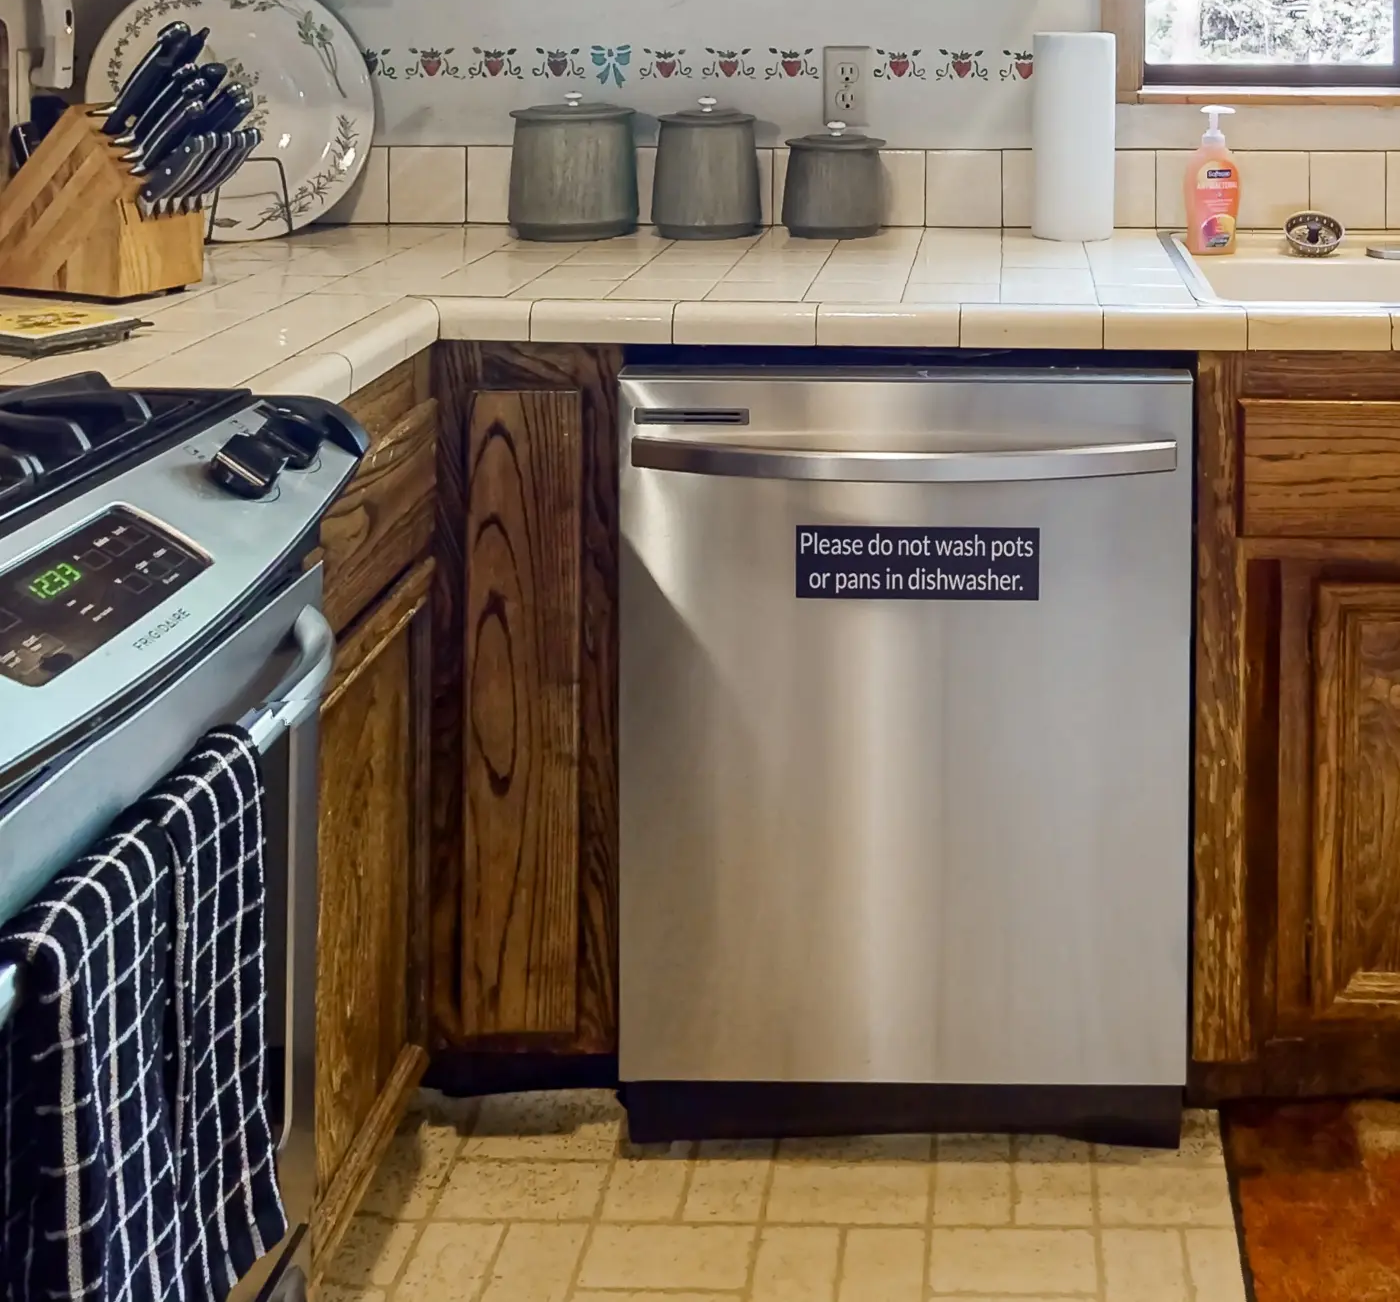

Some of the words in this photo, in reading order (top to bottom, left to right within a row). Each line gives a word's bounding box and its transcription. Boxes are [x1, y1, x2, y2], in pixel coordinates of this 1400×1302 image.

[800, 532, 864, 556] Please
[867, 533, 893, 556] do
[898, 535, 931, 557] not
[935, 534, 986, 557] wash
[991, 536, 1034, 562] pots
[809, 571, 831, 590] or
[835, 571, 881, 594] pans
[886, 567, 903, 590] in
[907, 567, 1024, 592] dishwasher.
[132, 608, 191, 651] FRIGIDAIRE
